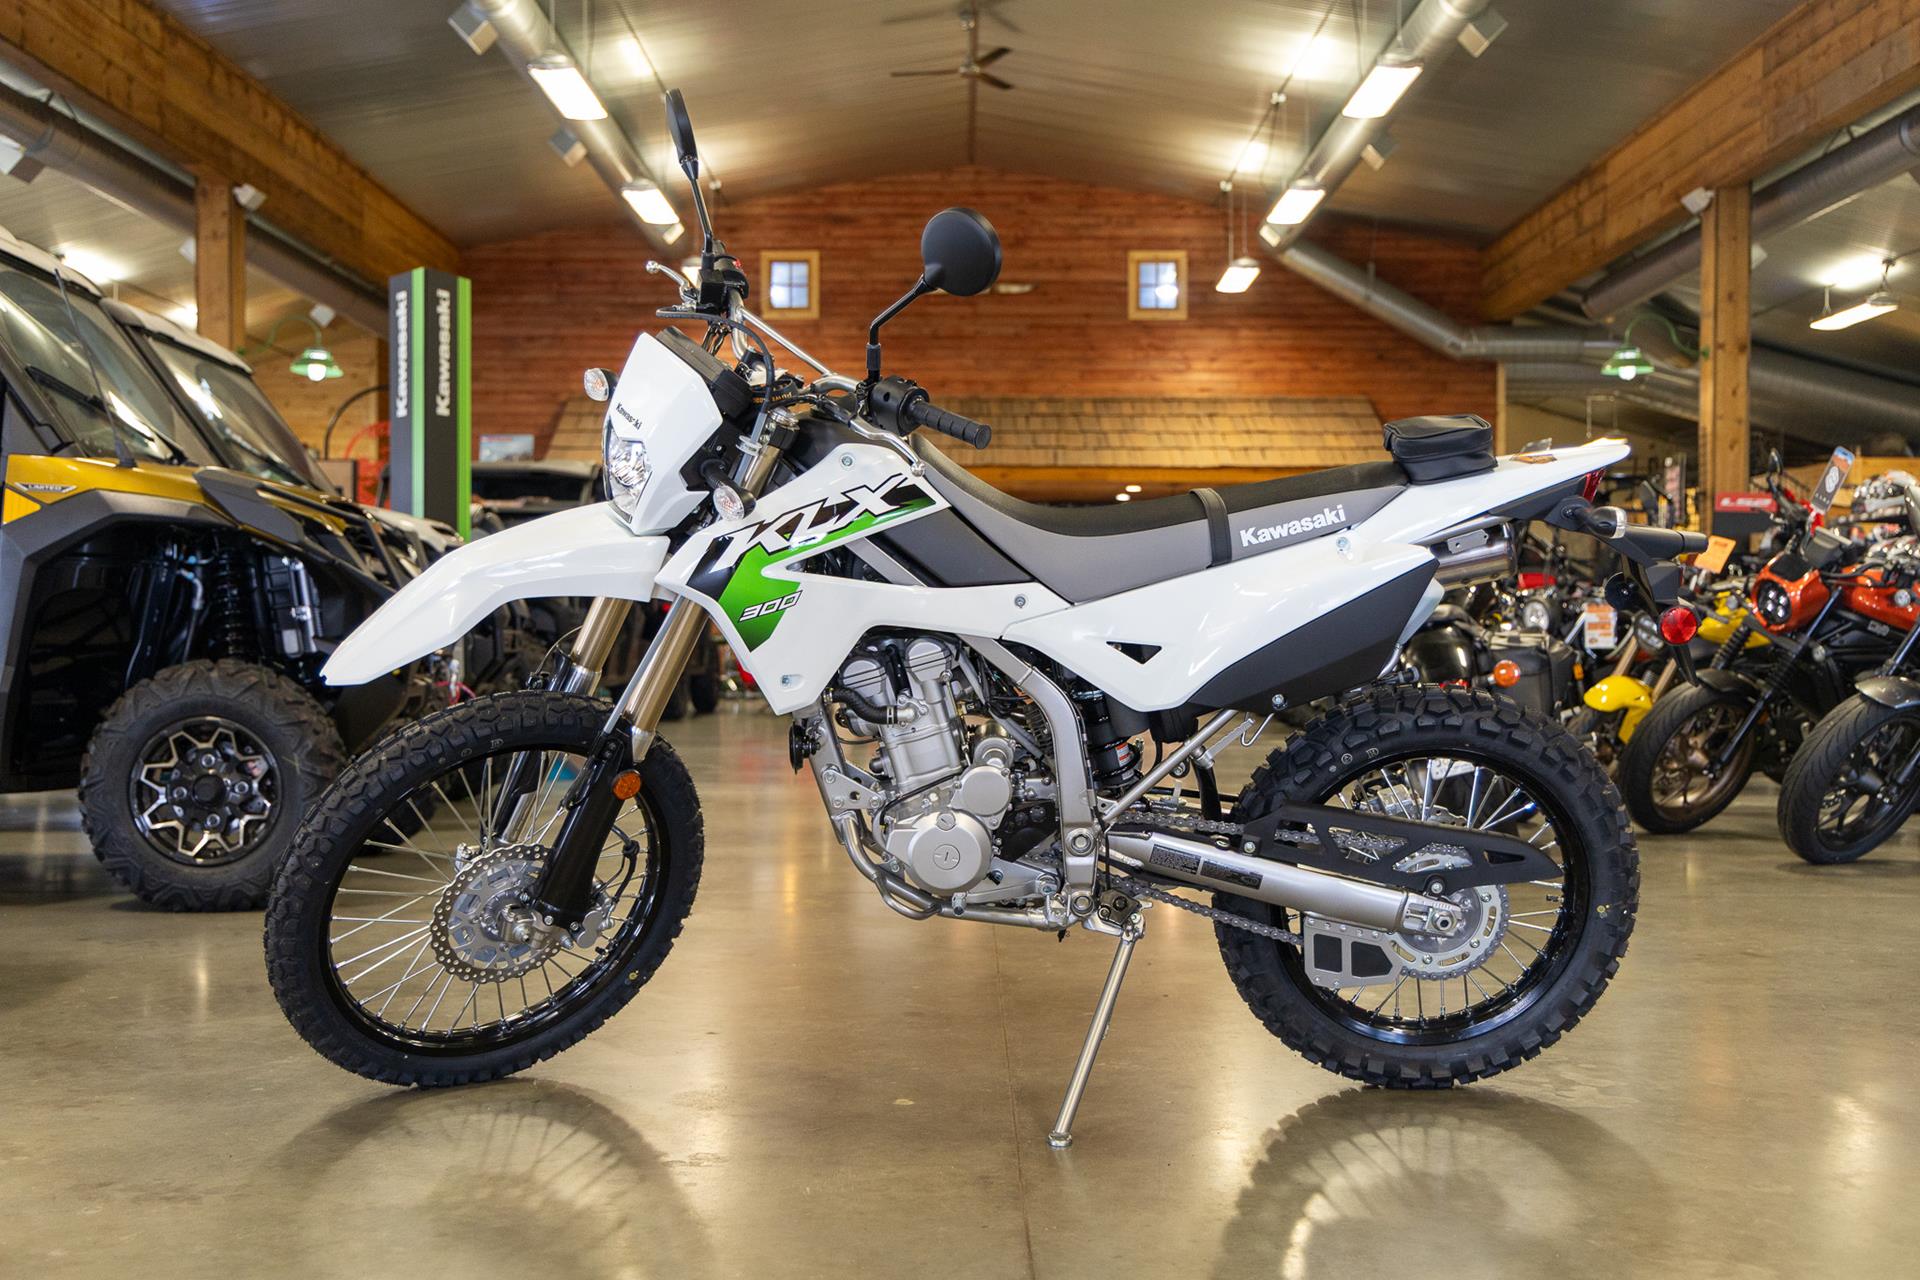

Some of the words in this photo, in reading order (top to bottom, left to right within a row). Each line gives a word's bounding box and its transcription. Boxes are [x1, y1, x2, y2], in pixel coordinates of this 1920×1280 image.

[395, 289, 408, 418] Kawasaki
[436, 288, 451, 417] Kawasaki
[708, 473, 909, 574] KLX
[1240, 504, 1346, 547] Kawasaki
[738, 590, 803, 623] 300
